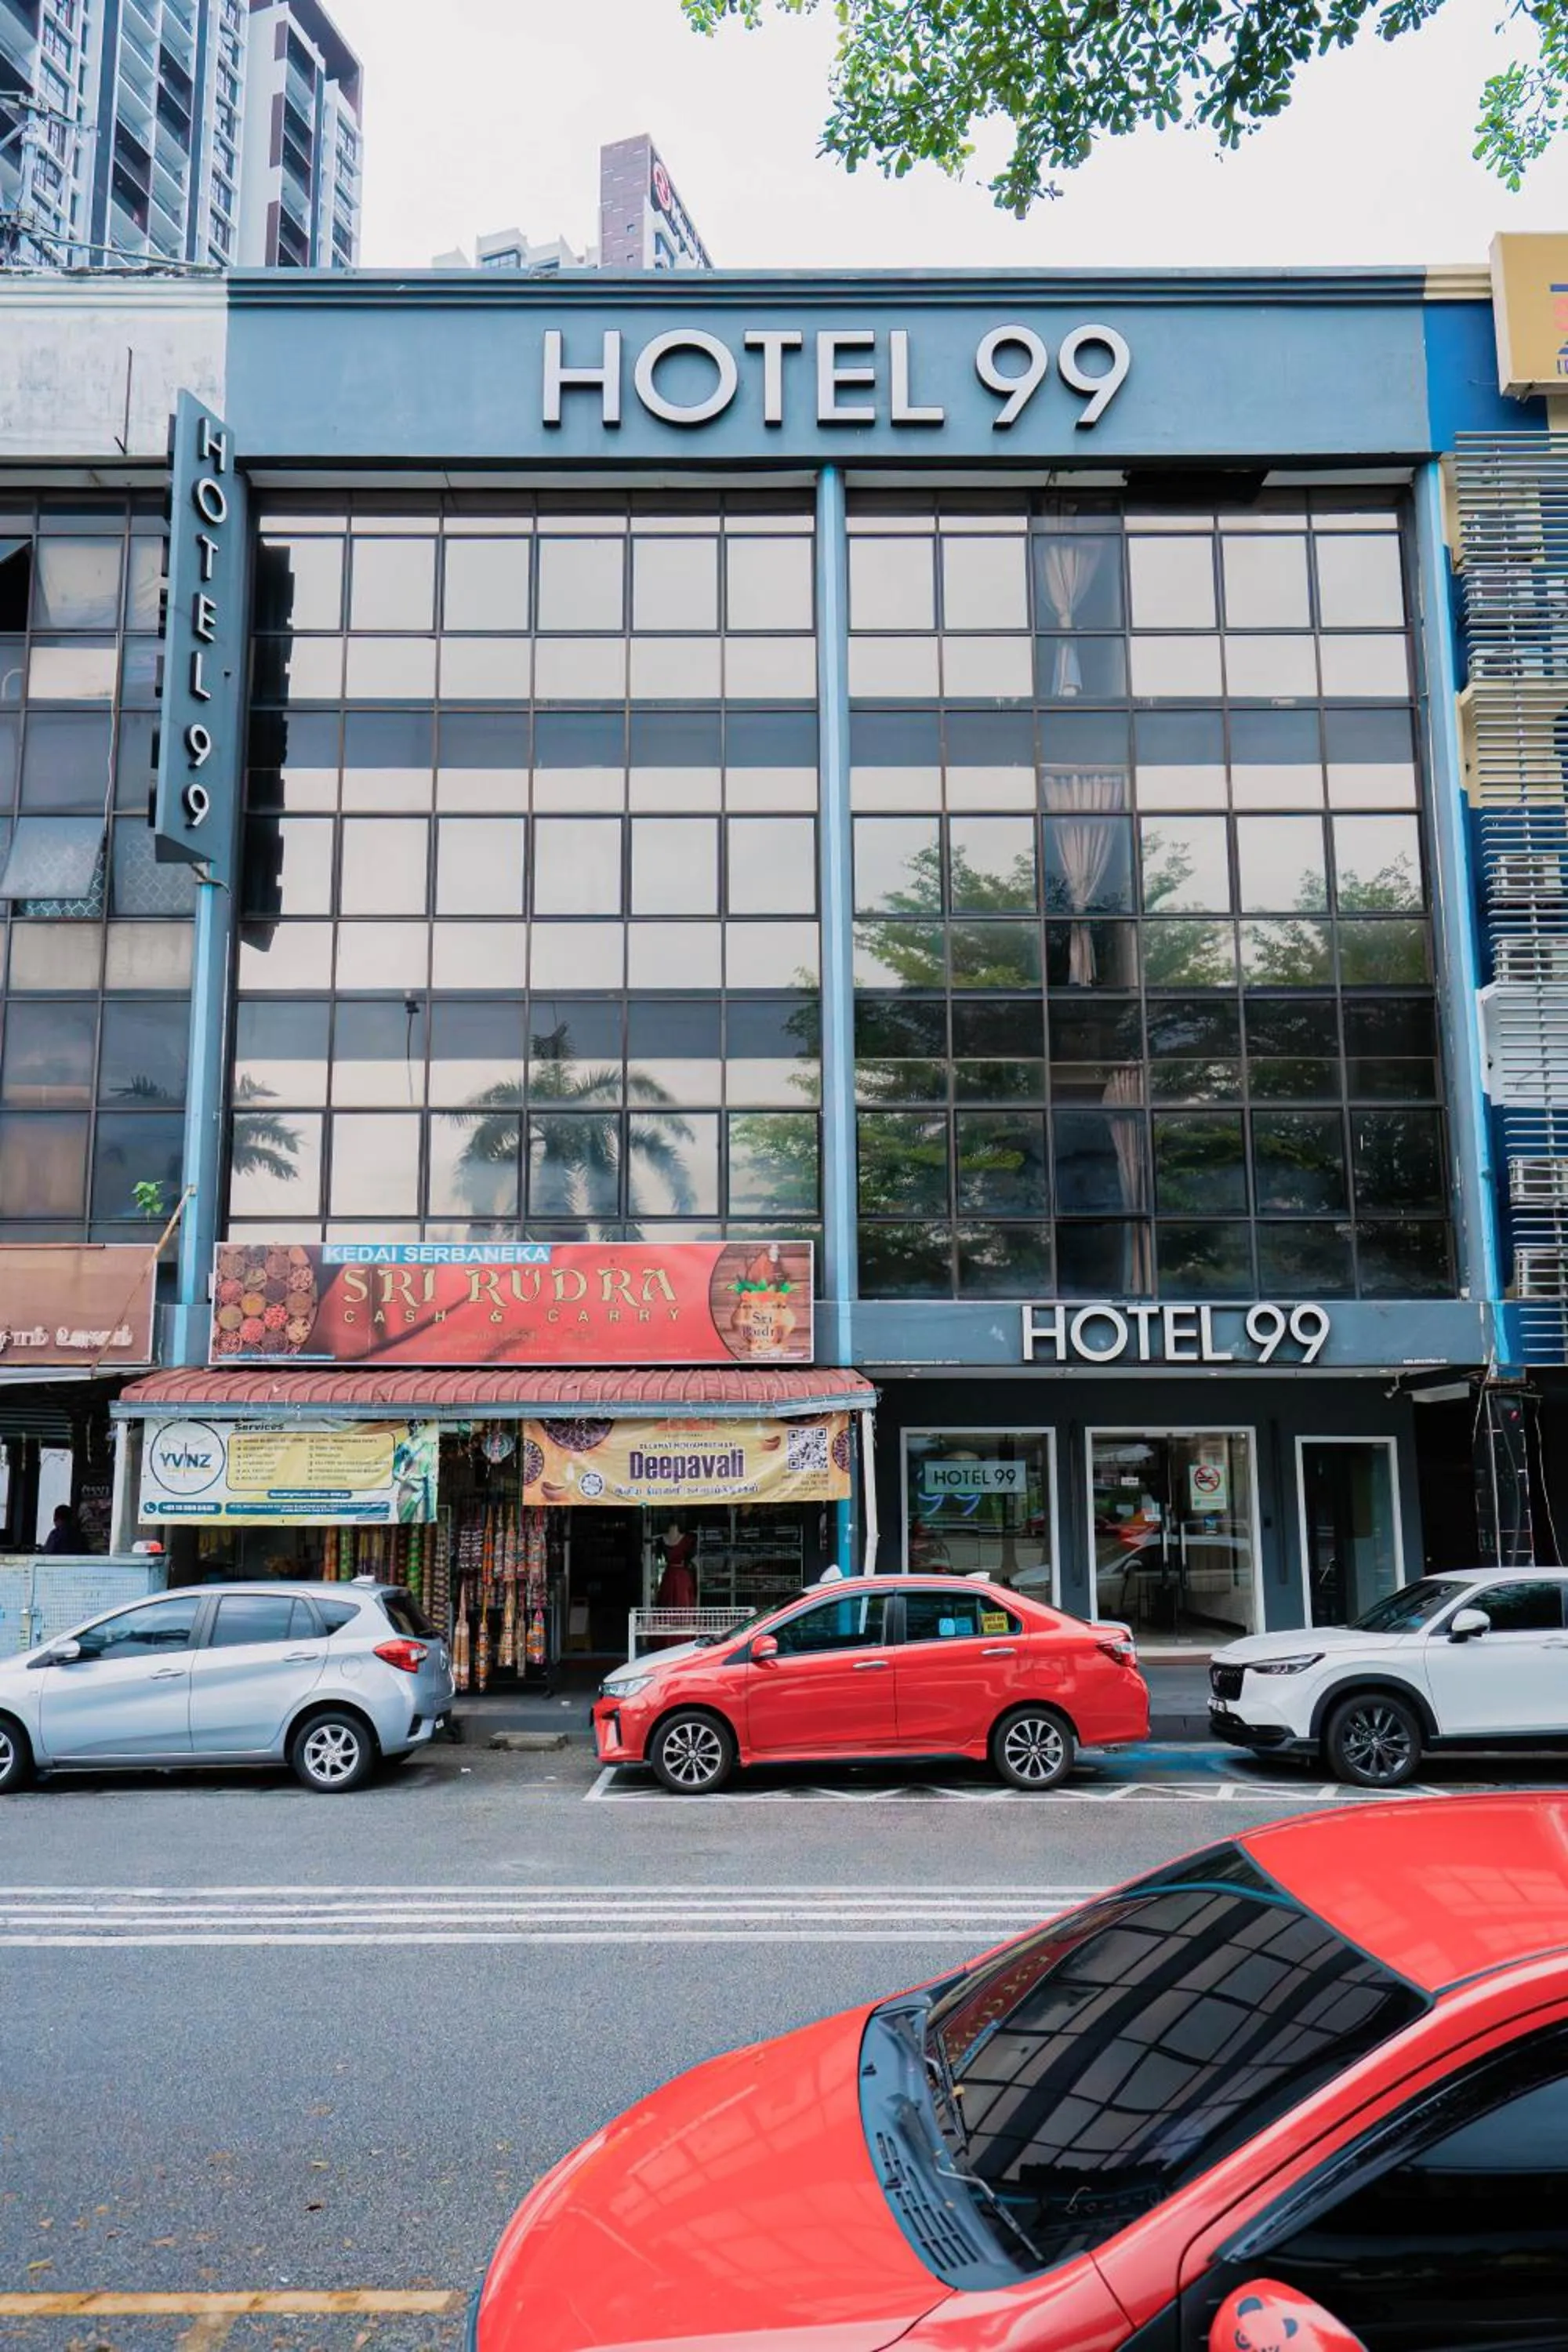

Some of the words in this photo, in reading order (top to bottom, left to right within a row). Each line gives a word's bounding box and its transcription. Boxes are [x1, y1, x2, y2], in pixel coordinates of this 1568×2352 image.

[543, 328, 945, 426] HOTEL
[975, 324, 1131, 429] 99
[193, 417, 227, 699] HOTEL
[185, 724, 212, 826] 99
[323, 1247, 396, 1262] KEDAI
[404, 1247, 549, 1262] SERBANEKA
[343, 1269, 437, 1308] SRI
[463, 1268, 677, 1308] RUDRA
[343, 1309, 448, 1323] CASH
[490, 1310, 503, 1323] &
[548, 1309, 678, 1323] CARRY
[1022, 1305, 1233, 1362] HOTEL
[1246, 1304, 1330, 1363] 99
[234, 1422, 285, 1431] Services
[630, 1449, 744, 1483] Deepavali
[934, 1470, 991, 1485] HOTEL
[994, 1468, 1017, 1485] 99
